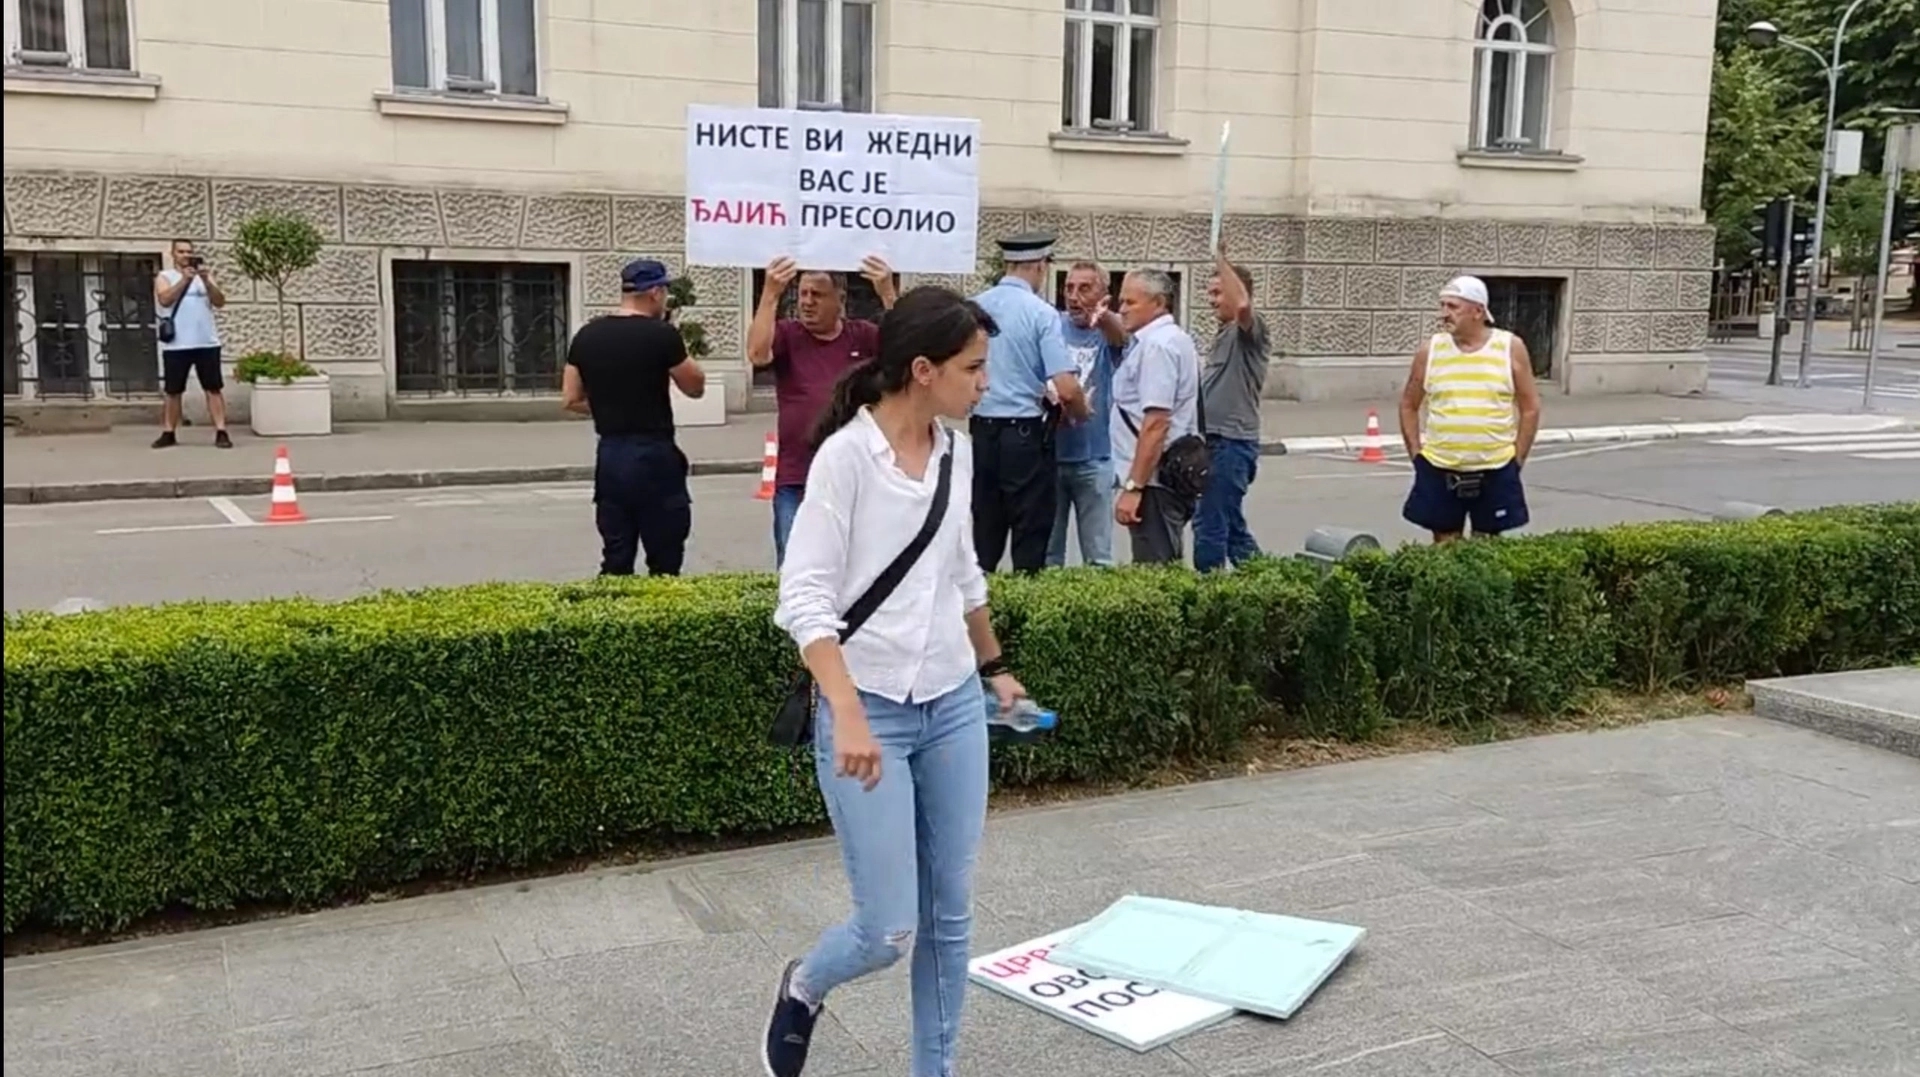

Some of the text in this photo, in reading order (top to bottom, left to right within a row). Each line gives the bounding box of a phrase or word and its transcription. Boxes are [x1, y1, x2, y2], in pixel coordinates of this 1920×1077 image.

[696, 122, 972, 160] НИСТЕ ВИ ЖЕДНИ
[799, 168, 888, 195] ВАС ЈЕ
[690, 199, 956, 234] ЂАЈИЋ ПРЕСОЛИО
[1068, 981, 1165, 1018] ПОС
